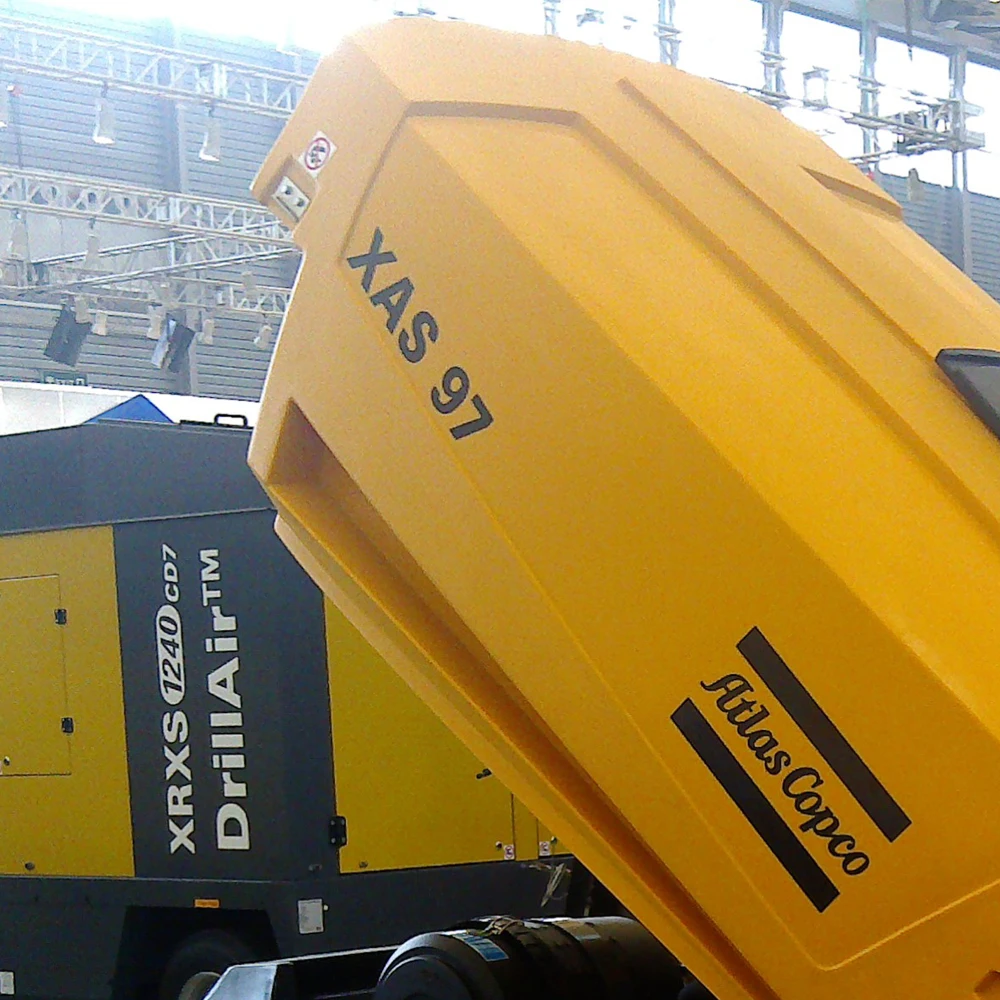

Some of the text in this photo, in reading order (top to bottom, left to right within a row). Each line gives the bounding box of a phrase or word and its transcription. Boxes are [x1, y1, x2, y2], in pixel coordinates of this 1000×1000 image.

[347, 227, 494, 440] XAS 97
[160, 544, 196, 855] XRXS 1240 CD7
[700, 673, 870, 876] Atlas Copco
